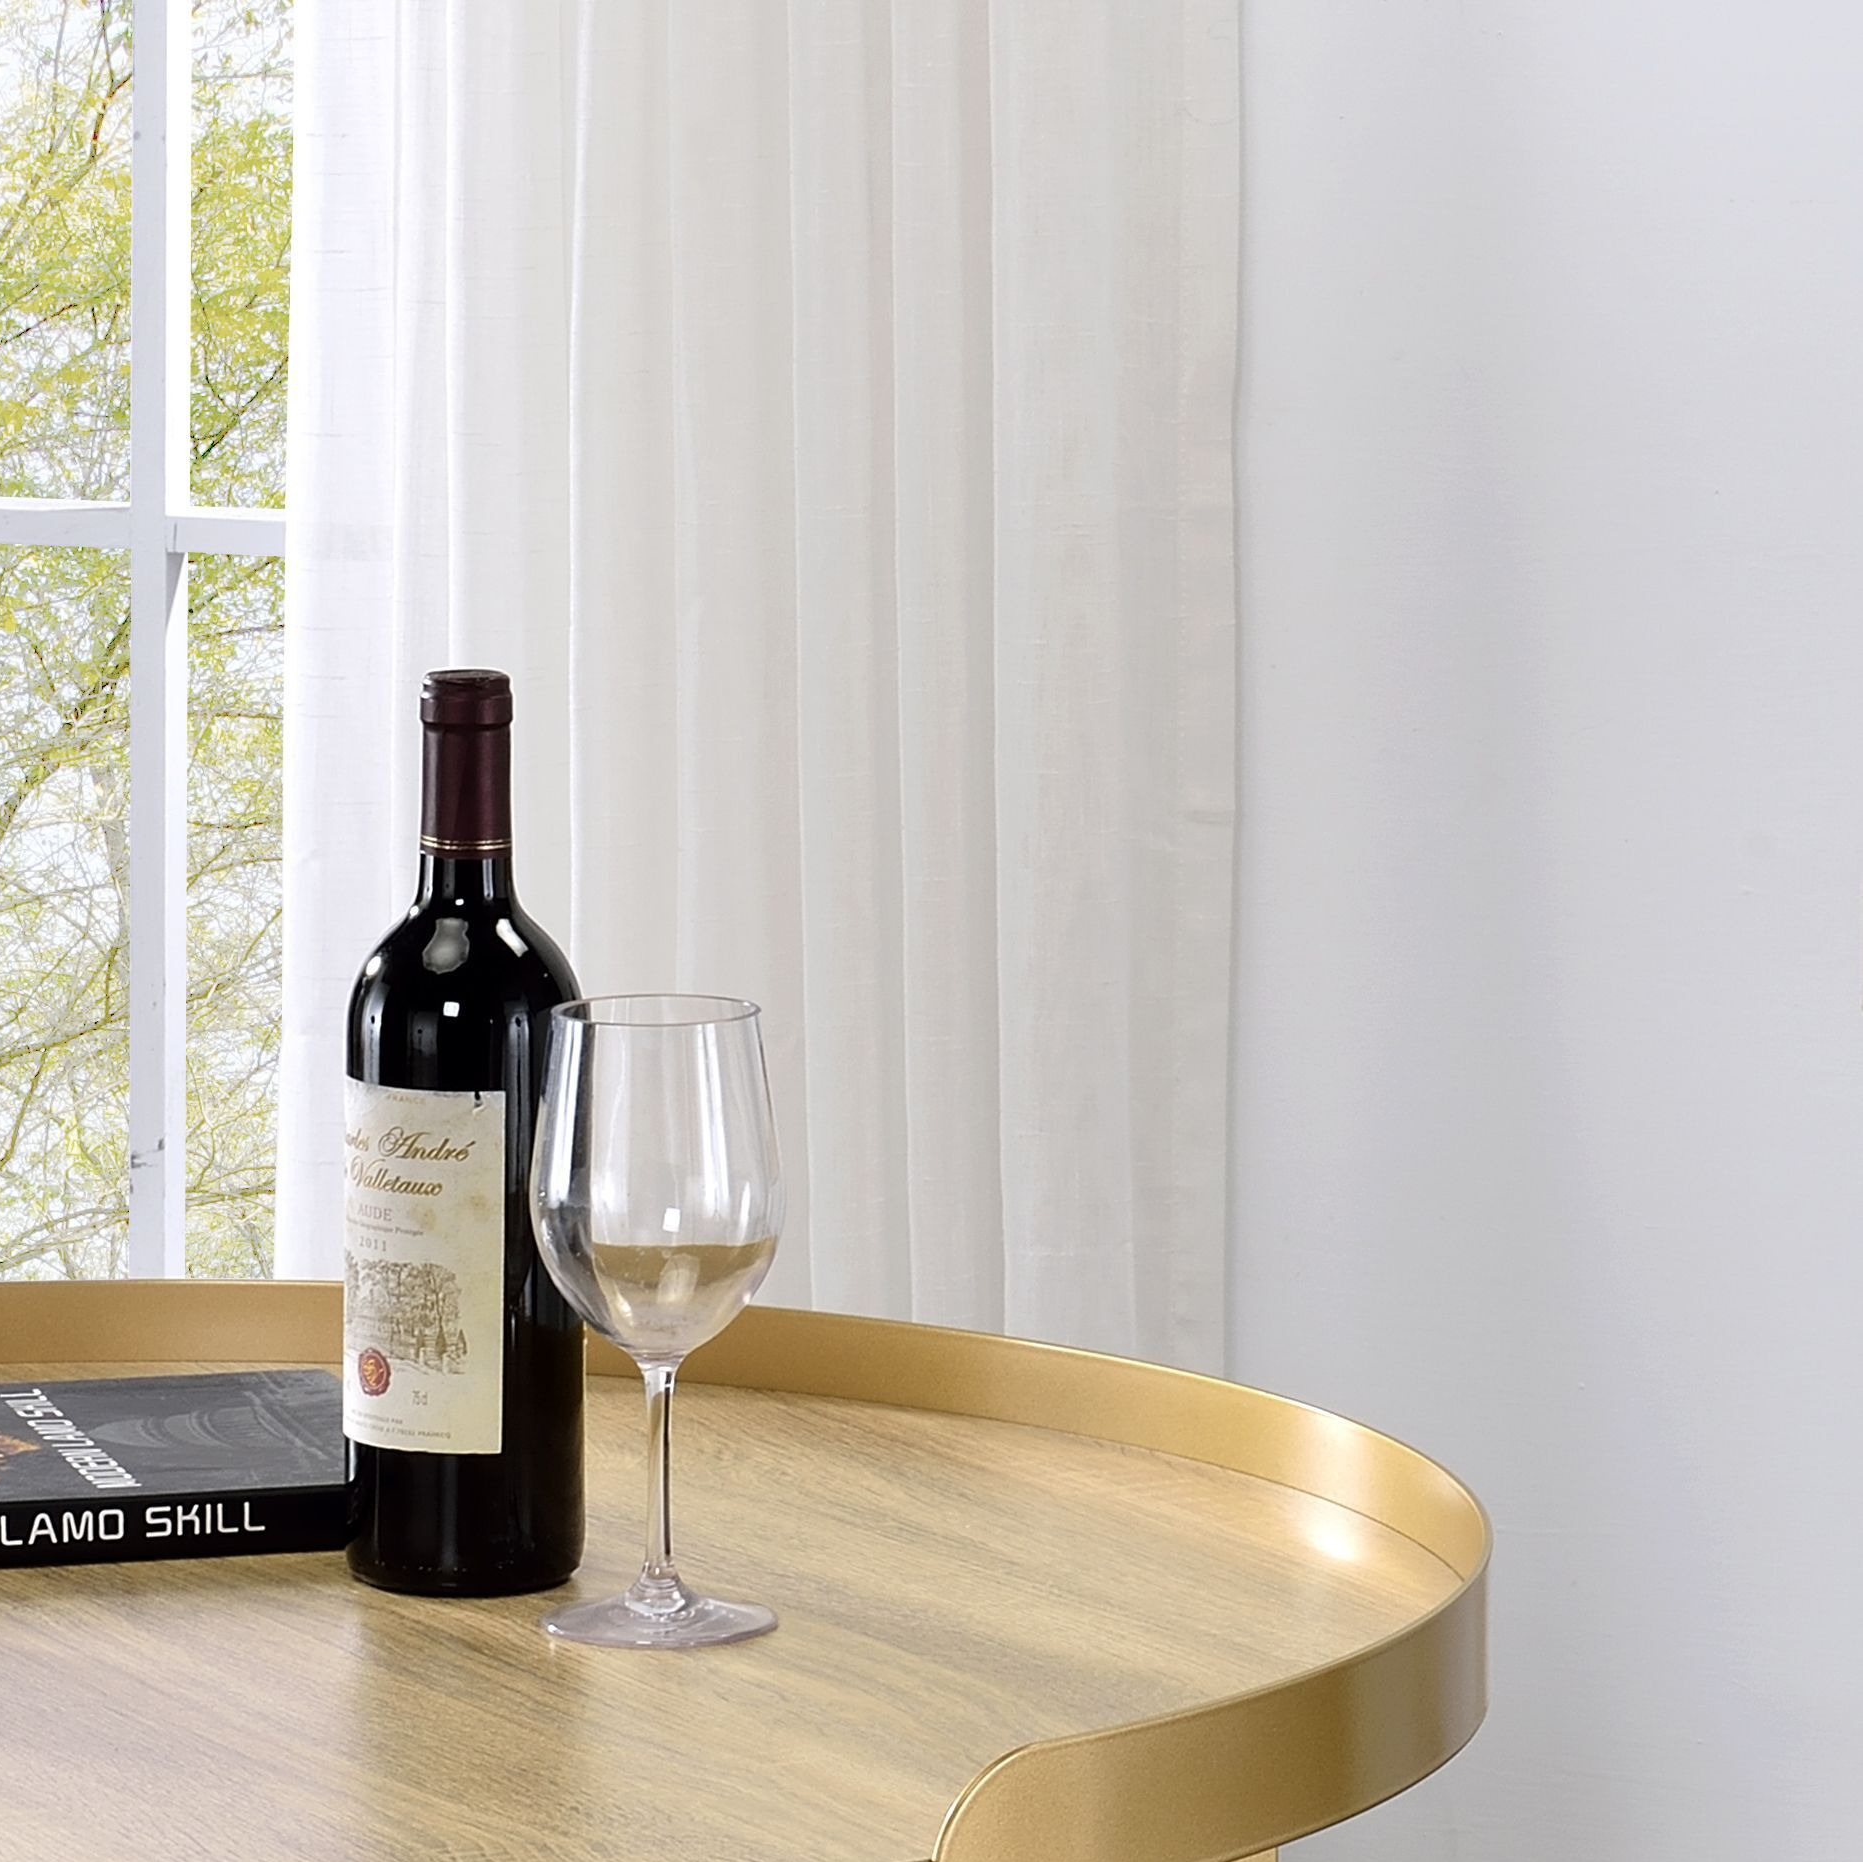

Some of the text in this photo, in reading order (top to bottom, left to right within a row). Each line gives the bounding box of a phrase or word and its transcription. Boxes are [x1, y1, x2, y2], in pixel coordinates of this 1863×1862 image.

[378, 1126, 476, 1161] André
[357, 1203, 393, 1221] AUDE
[359, 1236, 387, 1252] 2011
[0, 1509, 124, 1546] LAMO
[145, 1502, 266, 1538] SKILL
